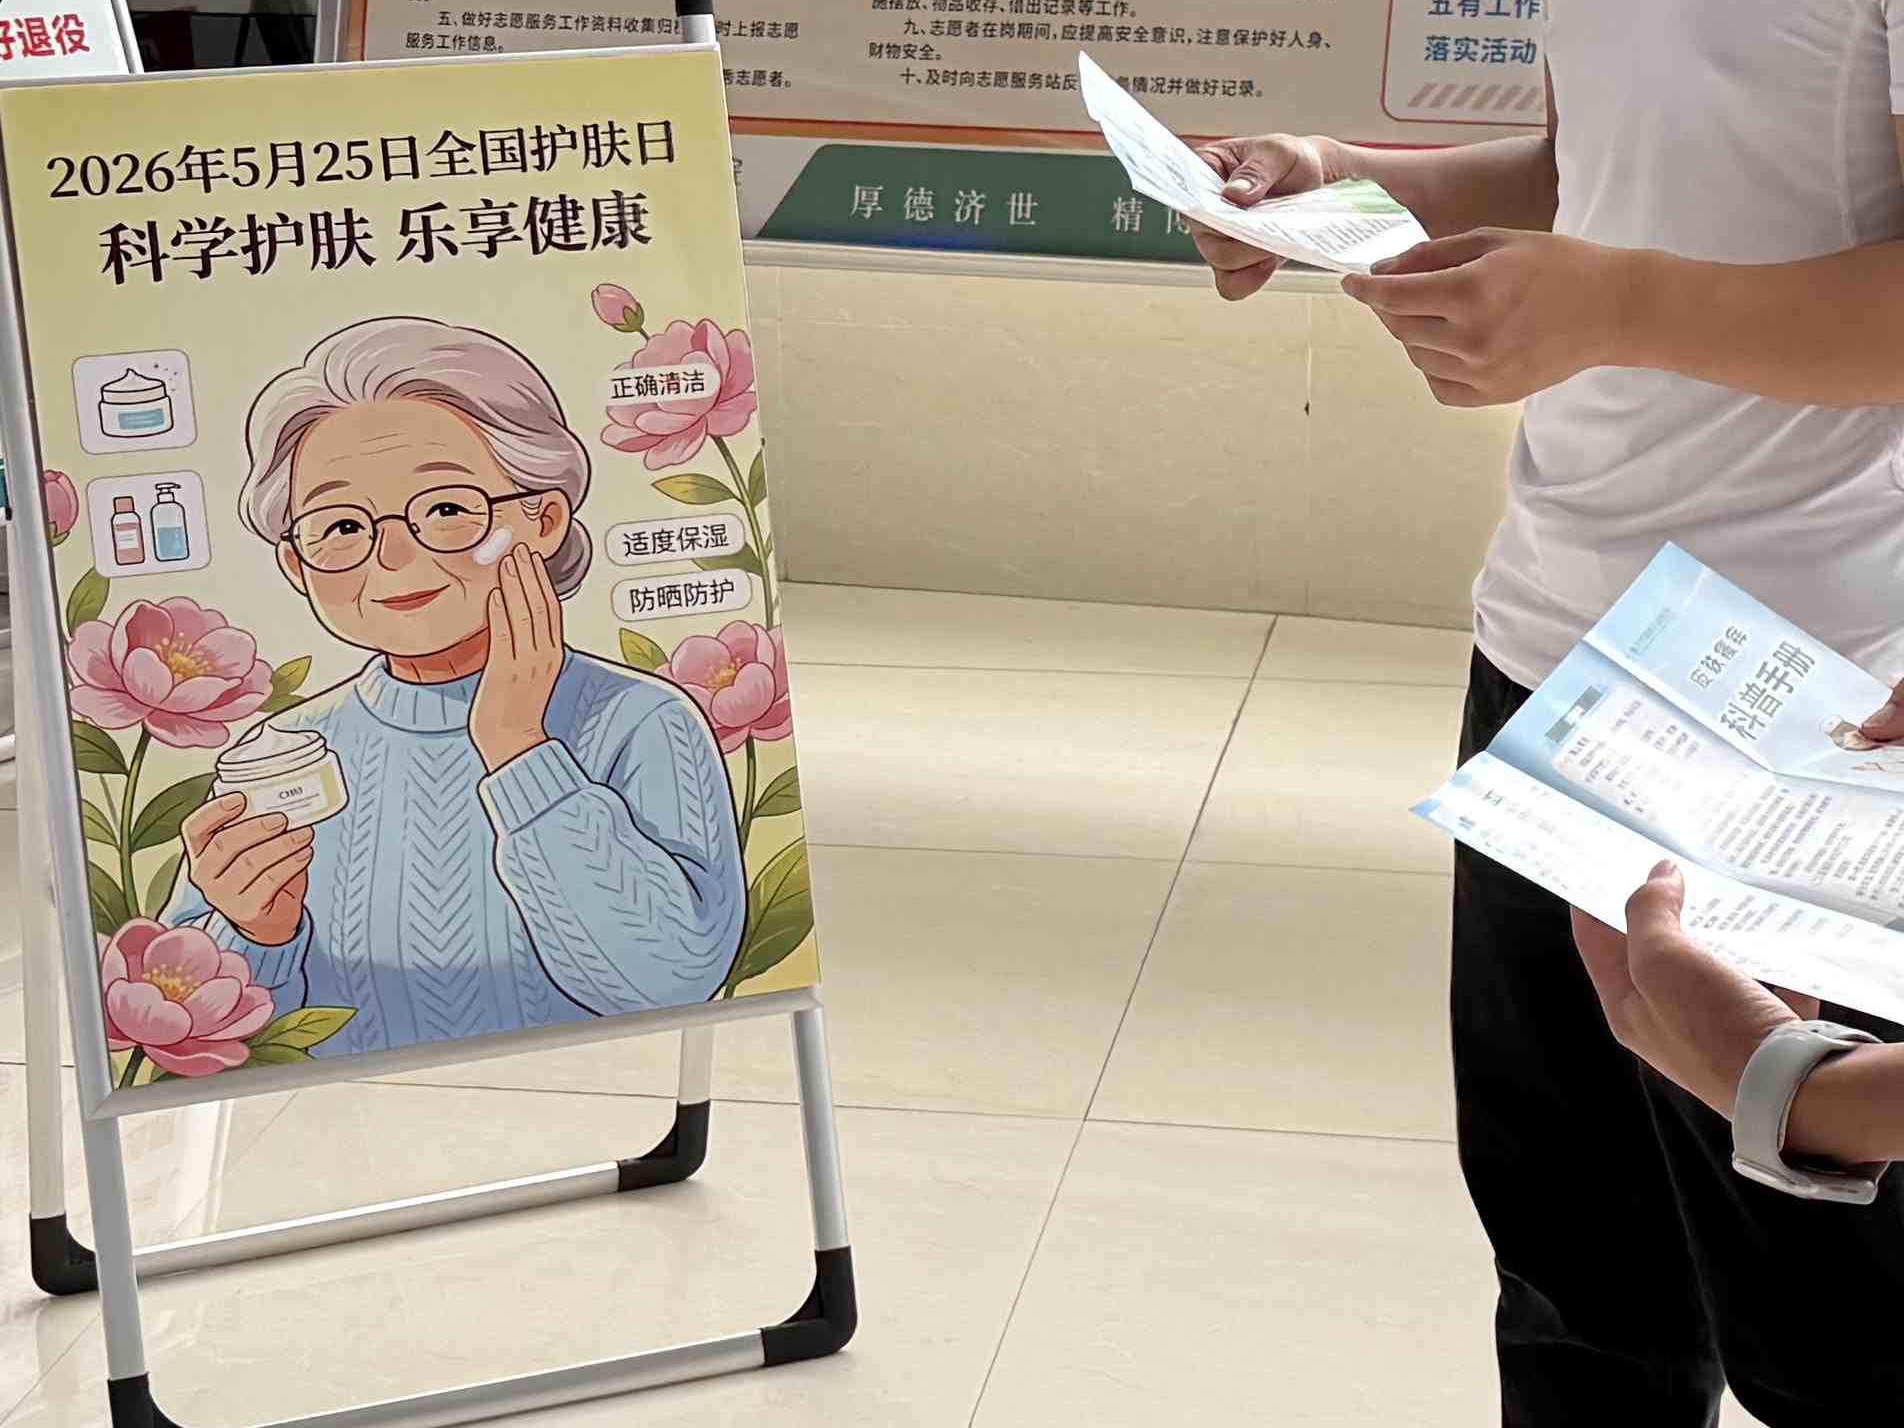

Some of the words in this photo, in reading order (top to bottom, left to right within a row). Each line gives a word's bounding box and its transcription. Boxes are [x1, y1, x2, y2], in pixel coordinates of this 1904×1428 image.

[1424, 35, 1538, 65] 落实活动
[46, 117, 678, 199] 2026年5月25日全国护肤日
[851, 184, 1040, 229] 厚德济世
[98, 205, 379, 288] 科学护肤
[396, 187, 655, 267] 乐享健康
[609, 367, 708, 402] 正确清洁
[621, 522, 732, 559] 适度保湿
[629, 576, 737, 614] 防晒防护
[1720, 641, 1816, 741] 科普手册
